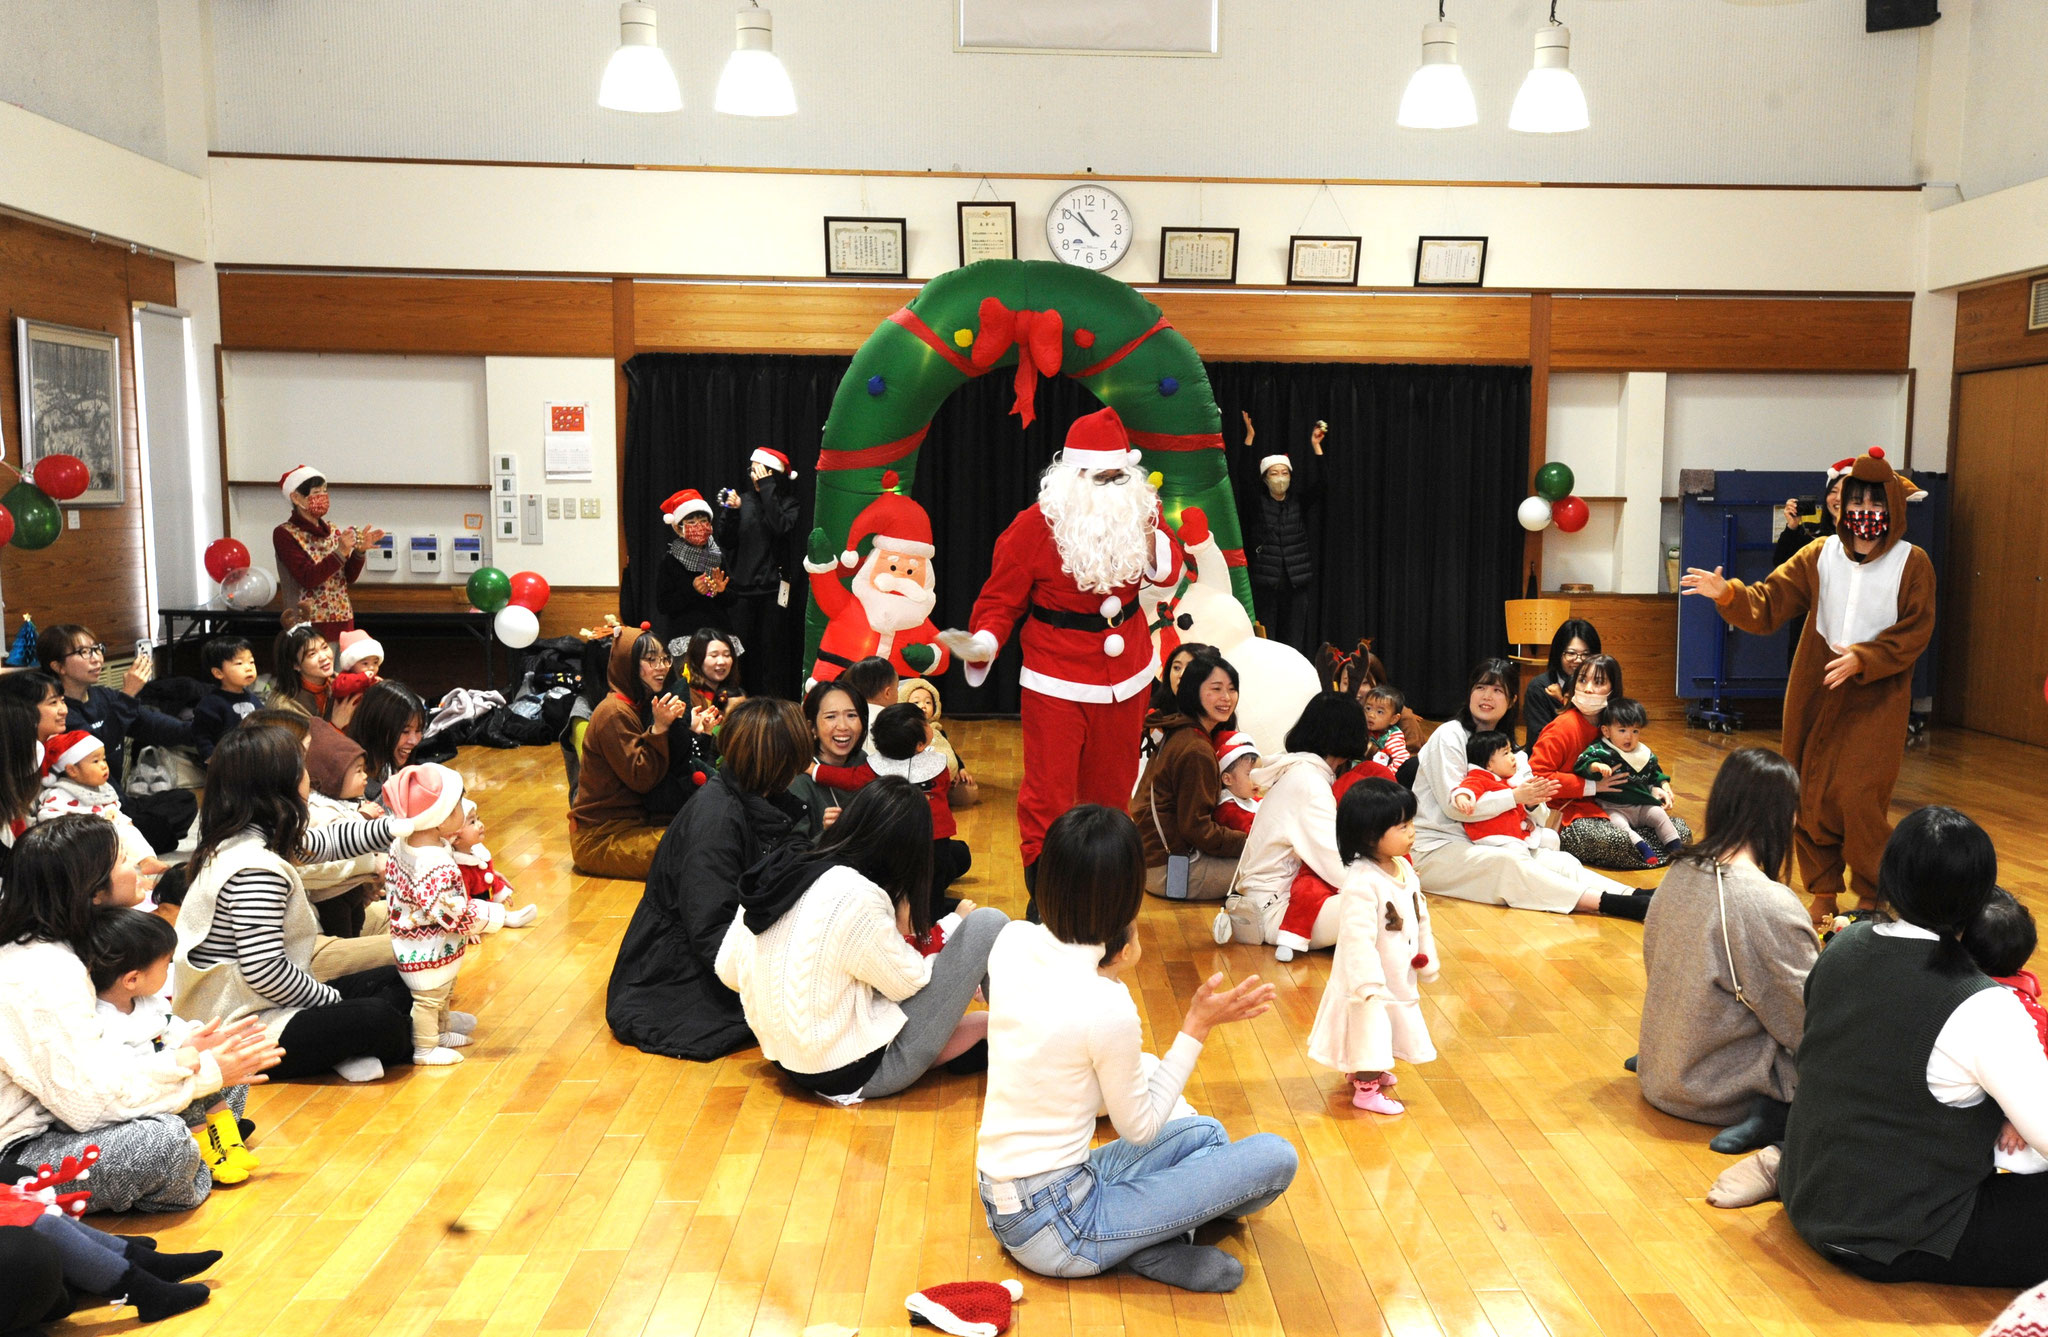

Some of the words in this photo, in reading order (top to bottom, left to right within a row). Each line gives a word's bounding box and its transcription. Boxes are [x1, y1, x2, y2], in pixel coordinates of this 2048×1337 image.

[1072, 198, 1081, 209] 11
[1084, 195, 1095, 206] 12
[1102, 198, 1106, 209] 1
[1061, 208, 1072, 220] 10
[1110, 209, 1118, 221] 2
[1057, 223, 1064, 234] 9
[1114, 224, 1122, 235] 3
[1062, 239, 1069, 250] 8
[1110, 240, 1118, 251] 4
[1073, 249, 1081, 260] 7
[1085, 252, 1094, 263] 6
[1099, 249, 1107, 261] 5
